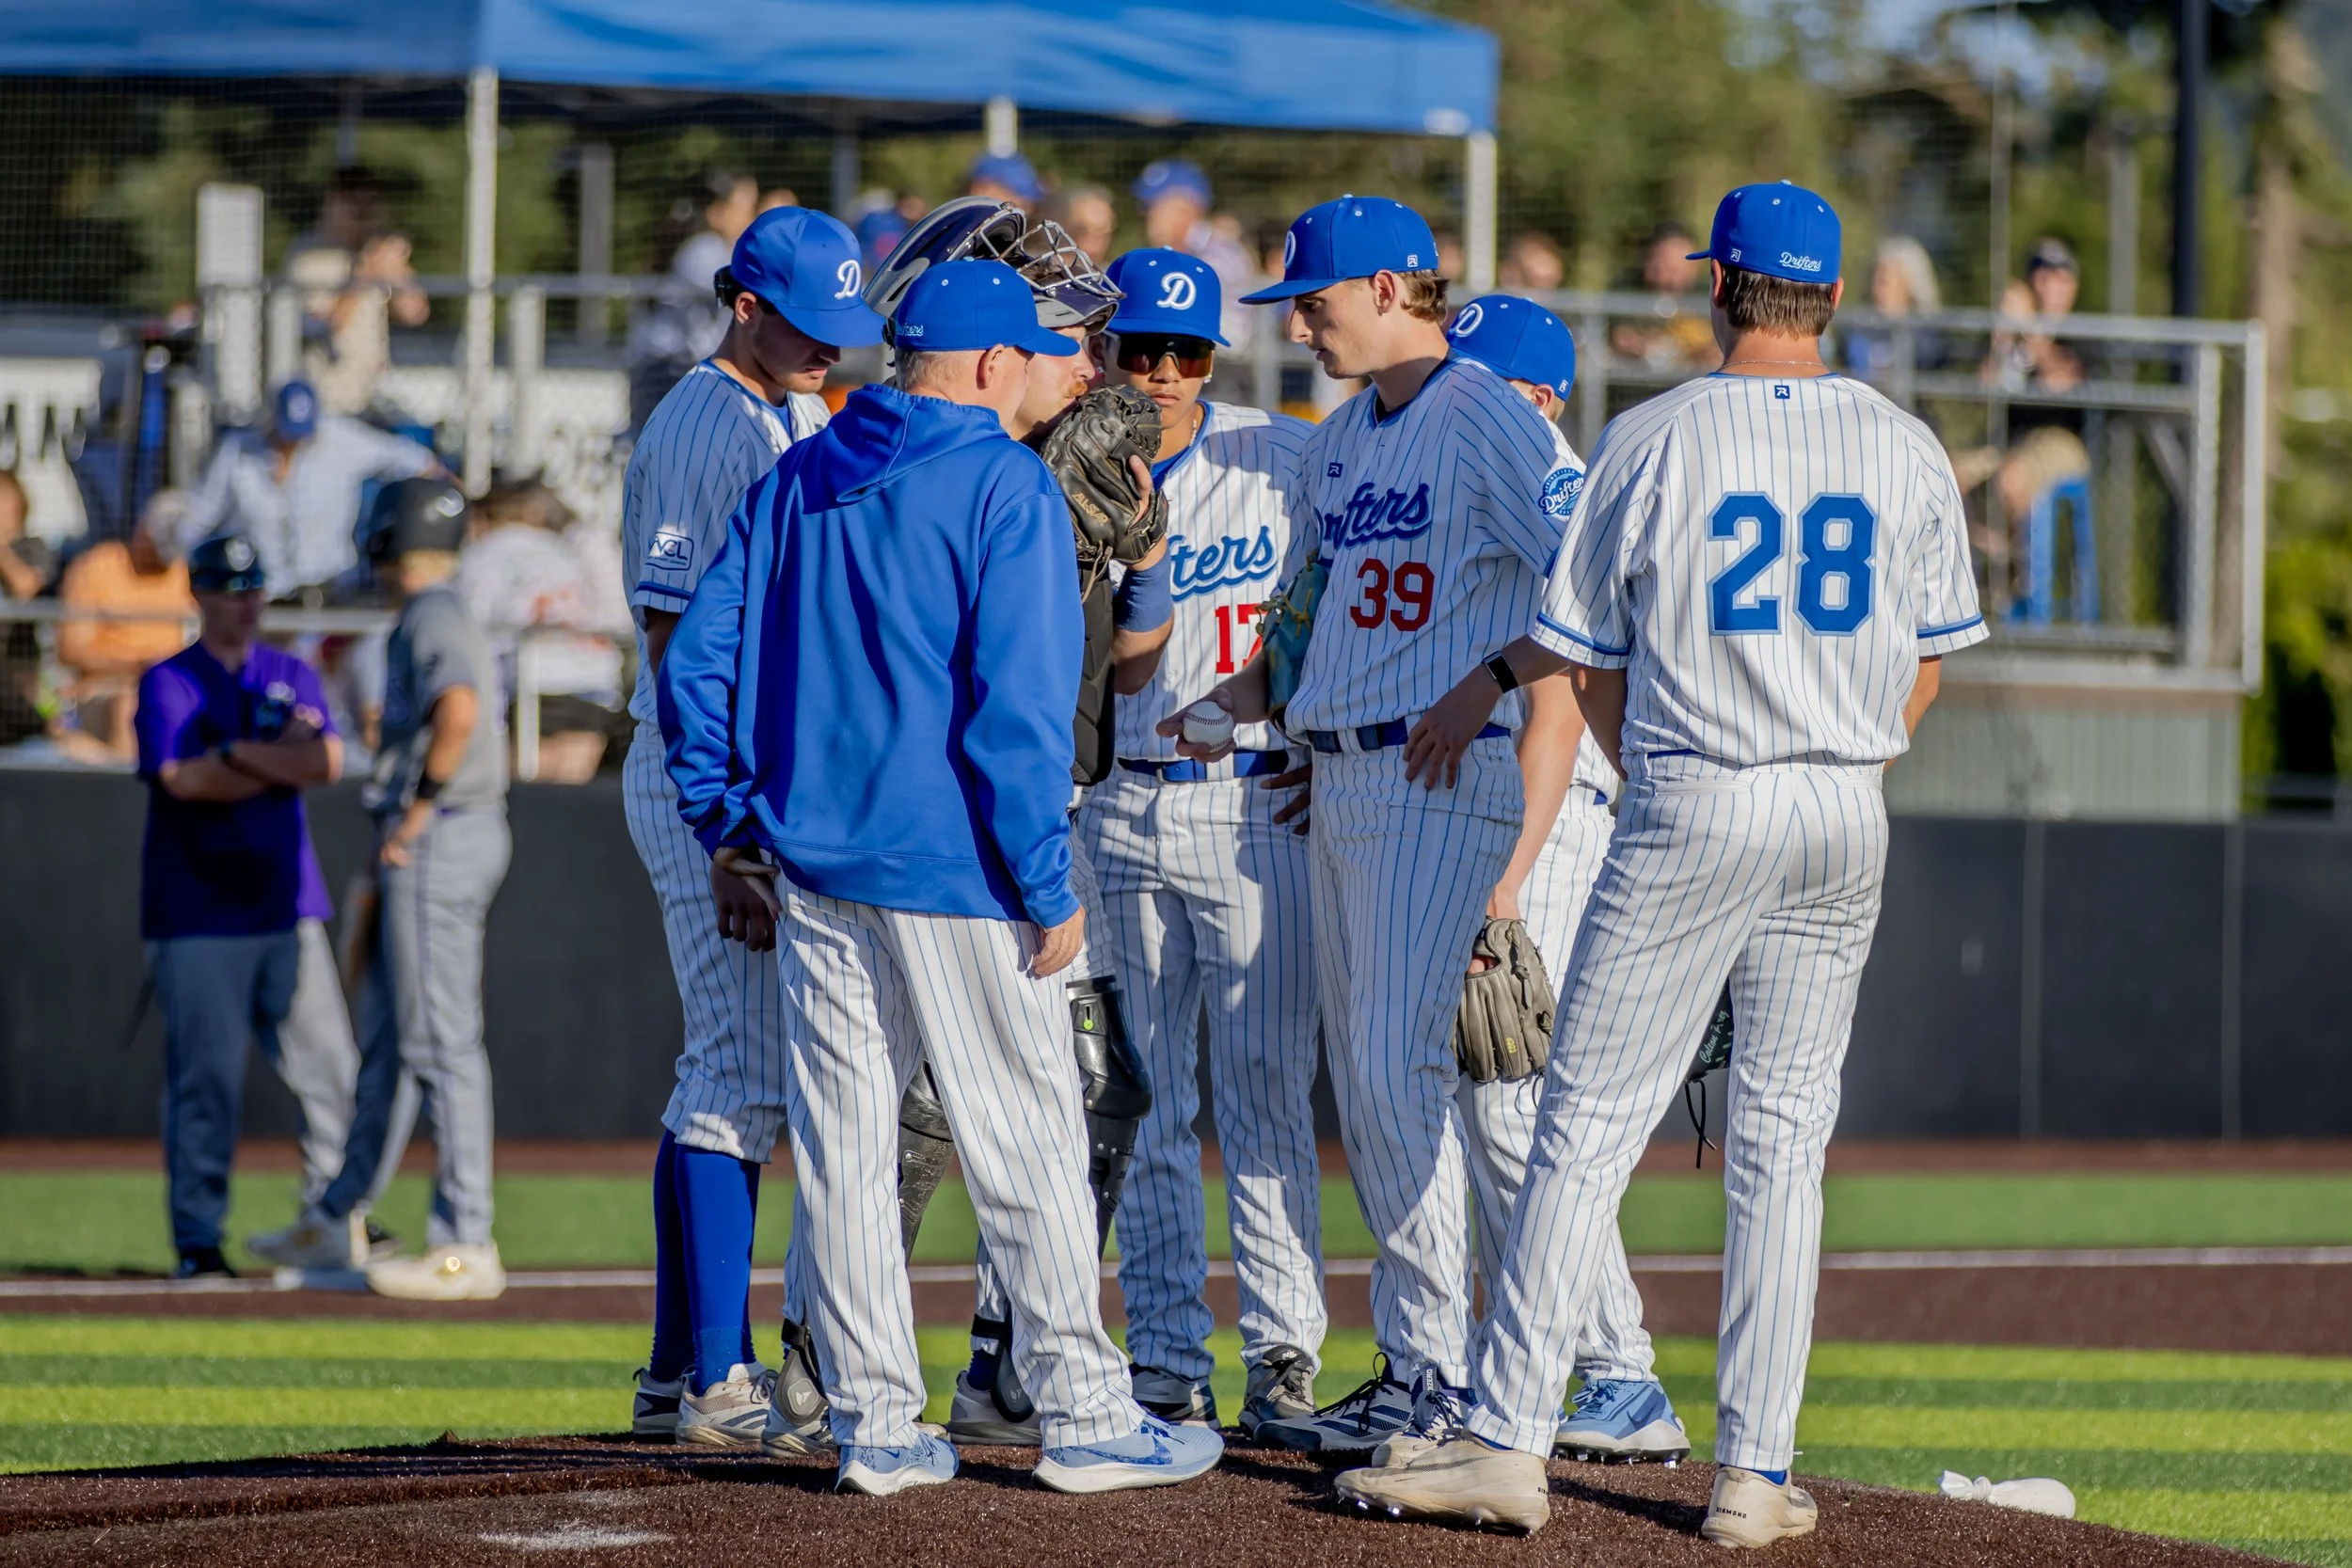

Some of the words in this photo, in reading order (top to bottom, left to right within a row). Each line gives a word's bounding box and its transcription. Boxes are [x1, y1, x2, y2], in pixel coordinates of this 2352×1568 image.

[834, 259, 861, 300] D
[1779, 251, 1822, 272] Drifters
[1156, 271, 1197, 310] D
[1706, 491, 1880, 637] 28
[1350, 558, 1435, 631] 39
